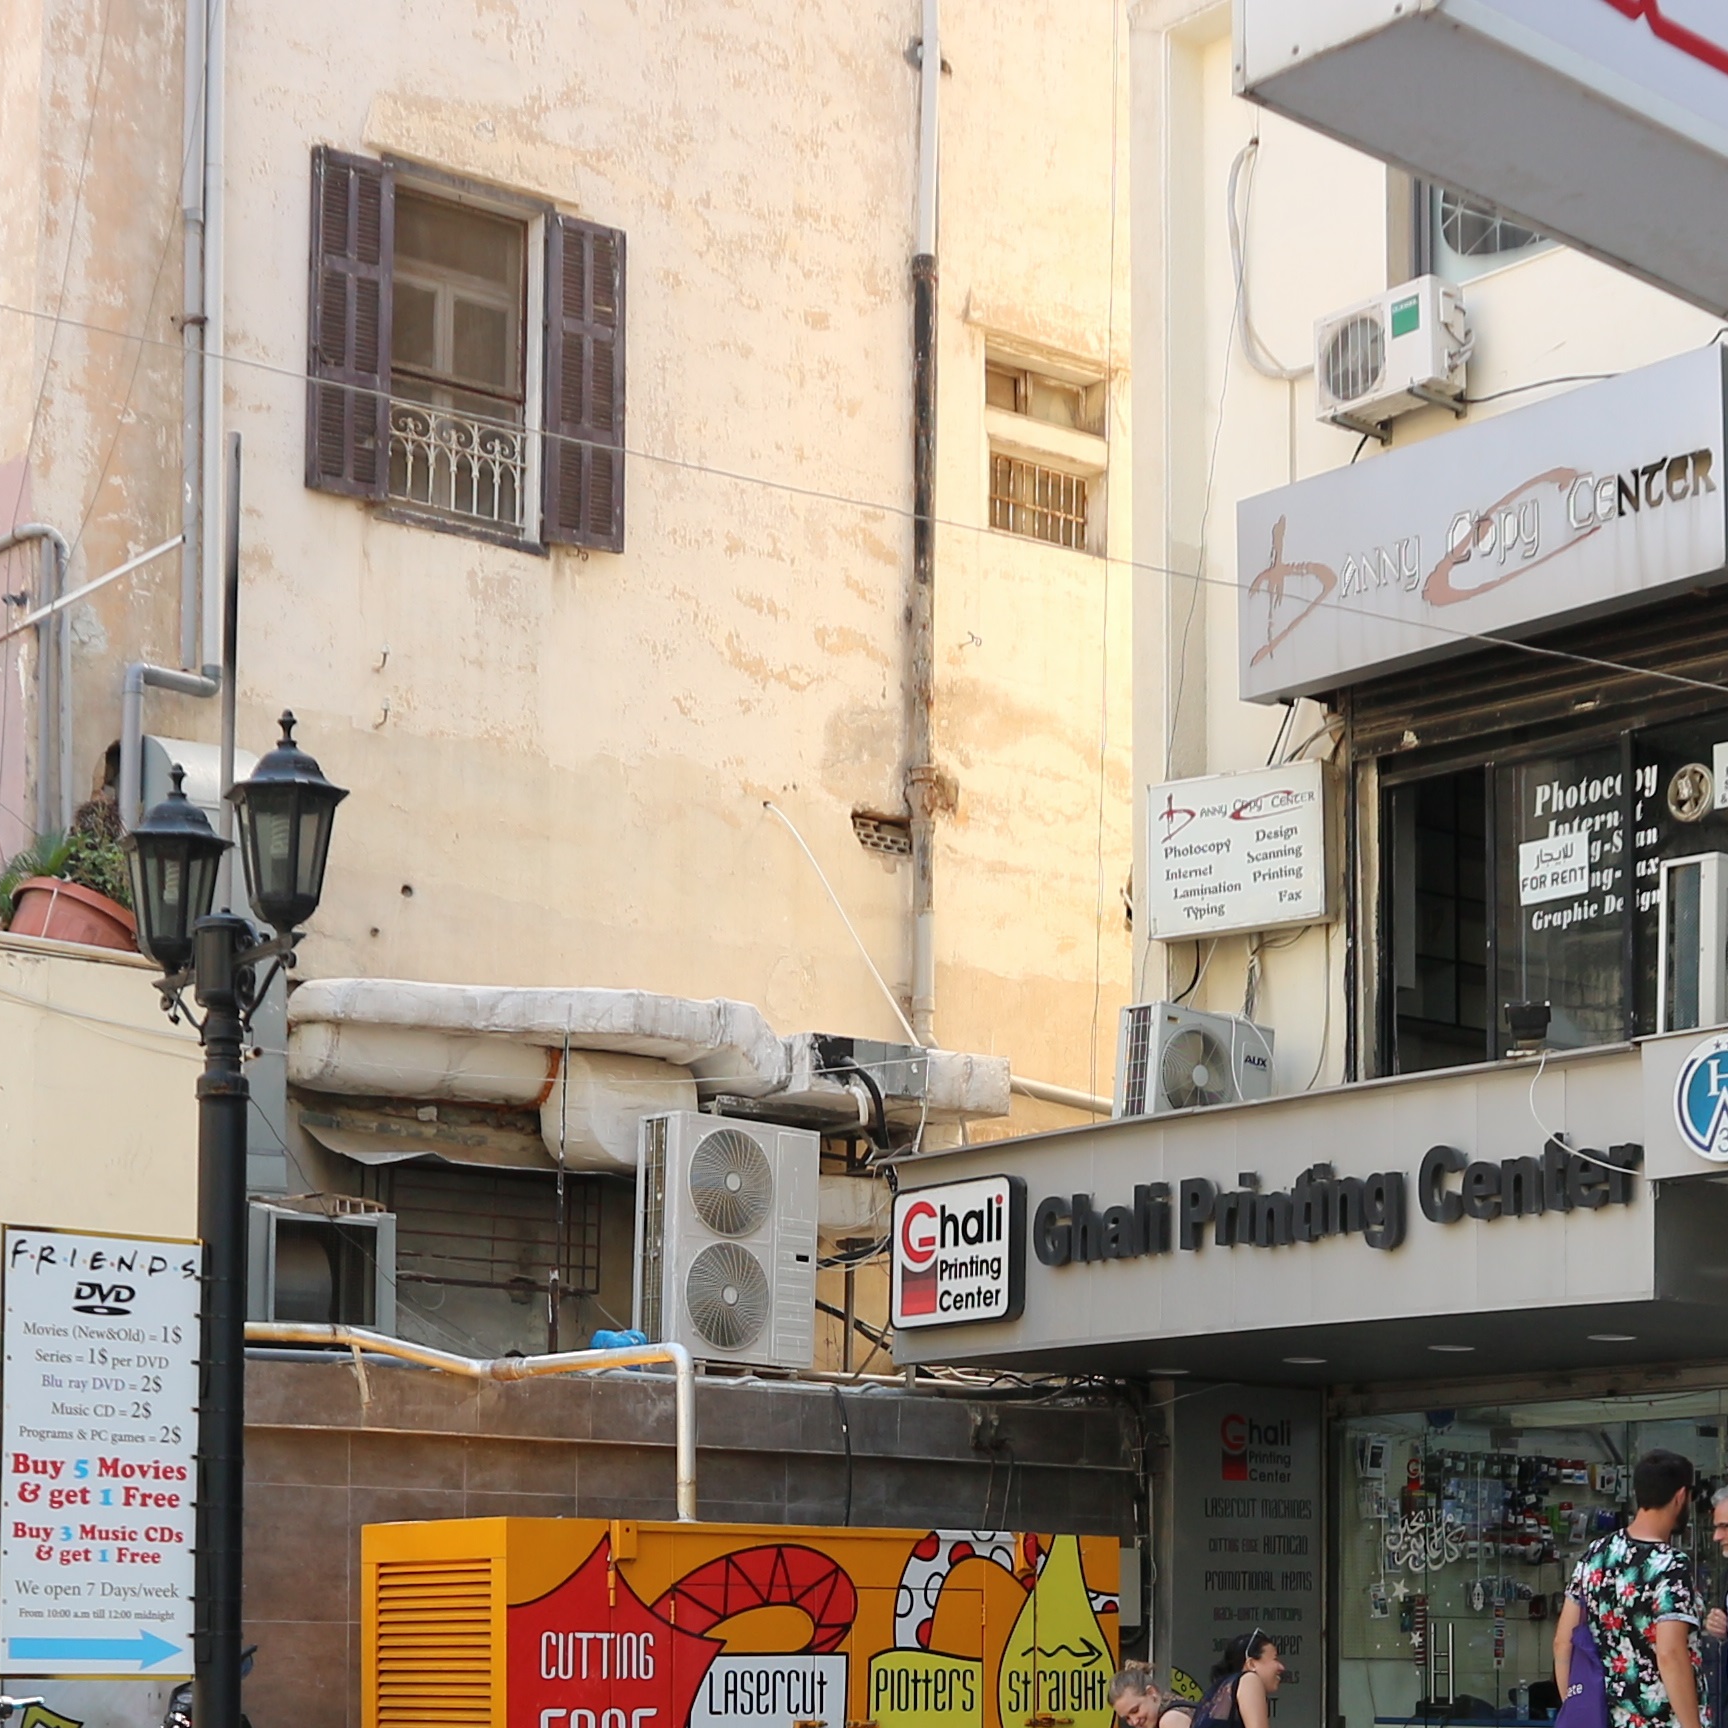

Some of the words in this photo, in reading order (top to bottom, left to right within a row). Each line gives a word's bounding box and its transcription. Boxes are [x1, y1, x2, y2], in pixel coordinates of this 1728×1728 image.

[1255, 825, 1298, 843] Design
[1164, 839, 1231, 860] Photocopy
[1246, 844, 1303, 864] Scanning
[1165, 864, 1213, 881] Internet
[1252, 864, 1303, 883] Printing
[1521, 874, 1547, 892] FOR
[1551, 865, 1586, 886] RENT
[1173, 881, 1242, 900] Lamination
[1278, 889, 1303, 903] Fax
[1183, 902, 1226, 920] Typing
[1532, 900, 1598, 931] Graphic
[1244, 1055, 1267, 1067] AUX
[1033, 1182, 1172, 1267] Ghali
[1180, 1161, 1407, 1250] Printing
[1418, 1133, 1644, 1224] Center
[902, 1195, 1003, 1264] Ghali
[939, 1253, 1002, 1282] Printing
[74, 1281, 136, 1304] DVD
[939, 1286, 1002, 1314] Center
[23, 1321, 69, 1337] Movies
[72, 1325, 145, 1344] (New&Old)
[161, 1325, 182, 1345] 1$
[35, 1348, 72, 1363] Series
[88, 1348, 108, 1365] 1$
[111, 1357, 132, 1370] per
[136, 1356, 169, 1369] DVD
[41, 1374, 63, 1388] Blu
[68, 1380, 88, 1392] ray
[92, 1377, 125, 1391] DVD
[141, 1375, 162, 1393] 2$
[51, 1402, 90, 1417] Music
[93, 1404, 115, 1418] CD
[131, 1401, 152, 1419] 2$
[19, 1426, 73, 1443] Programs
[77, 1428, 87, 1440] &
[91, 1428, 108, 1441] PC
[111, 1432, 145, 1447] games
[160, 1426, 181, 1445] 2$
[1221, 1413, 1291, 1451] Ghali
[12, 1453, 65, 1479] Buy
[73, 1459, 89, 1479] 5
[97, 1457, 187, 1481] Movies
[1248, 1451, 1291, 1468] Printing
[1249, 1469, 1291, 1483] Center
[18, 1482, 41, 1503] &
[49, 1487, 91, 1509] get
[99, 1488, 113, 1506] 1
[122, 1486, 180, 1508] Free
[12, 1522, 54, 1542] Buy
[60, 1526, 72, 1541] 3
[79, 1524, 138, 1542] Music
[144, 1527, 184, 1543] CDs
[35, 1544, 54, 1561] &
[59, 1548, 92, 1566] get
[99, 1549, 109, 1563] 1
[116, 1548, 161, 1564] Free
[15, 1580, 39, 1595] We
[44, 1584, 81, 1599] open
[86, 1583, 95, 1596] 7
[101, 1582, 179, 1600] Days/week
[19, 1608, 44, 1618] From
[46, 1609, 71, 1618] 10:00
[108, 1610, 132, 1619] 12:00
[134, 1610, 174, 1622] midnight
[540, 1631, 654, 1682] CUTTING
